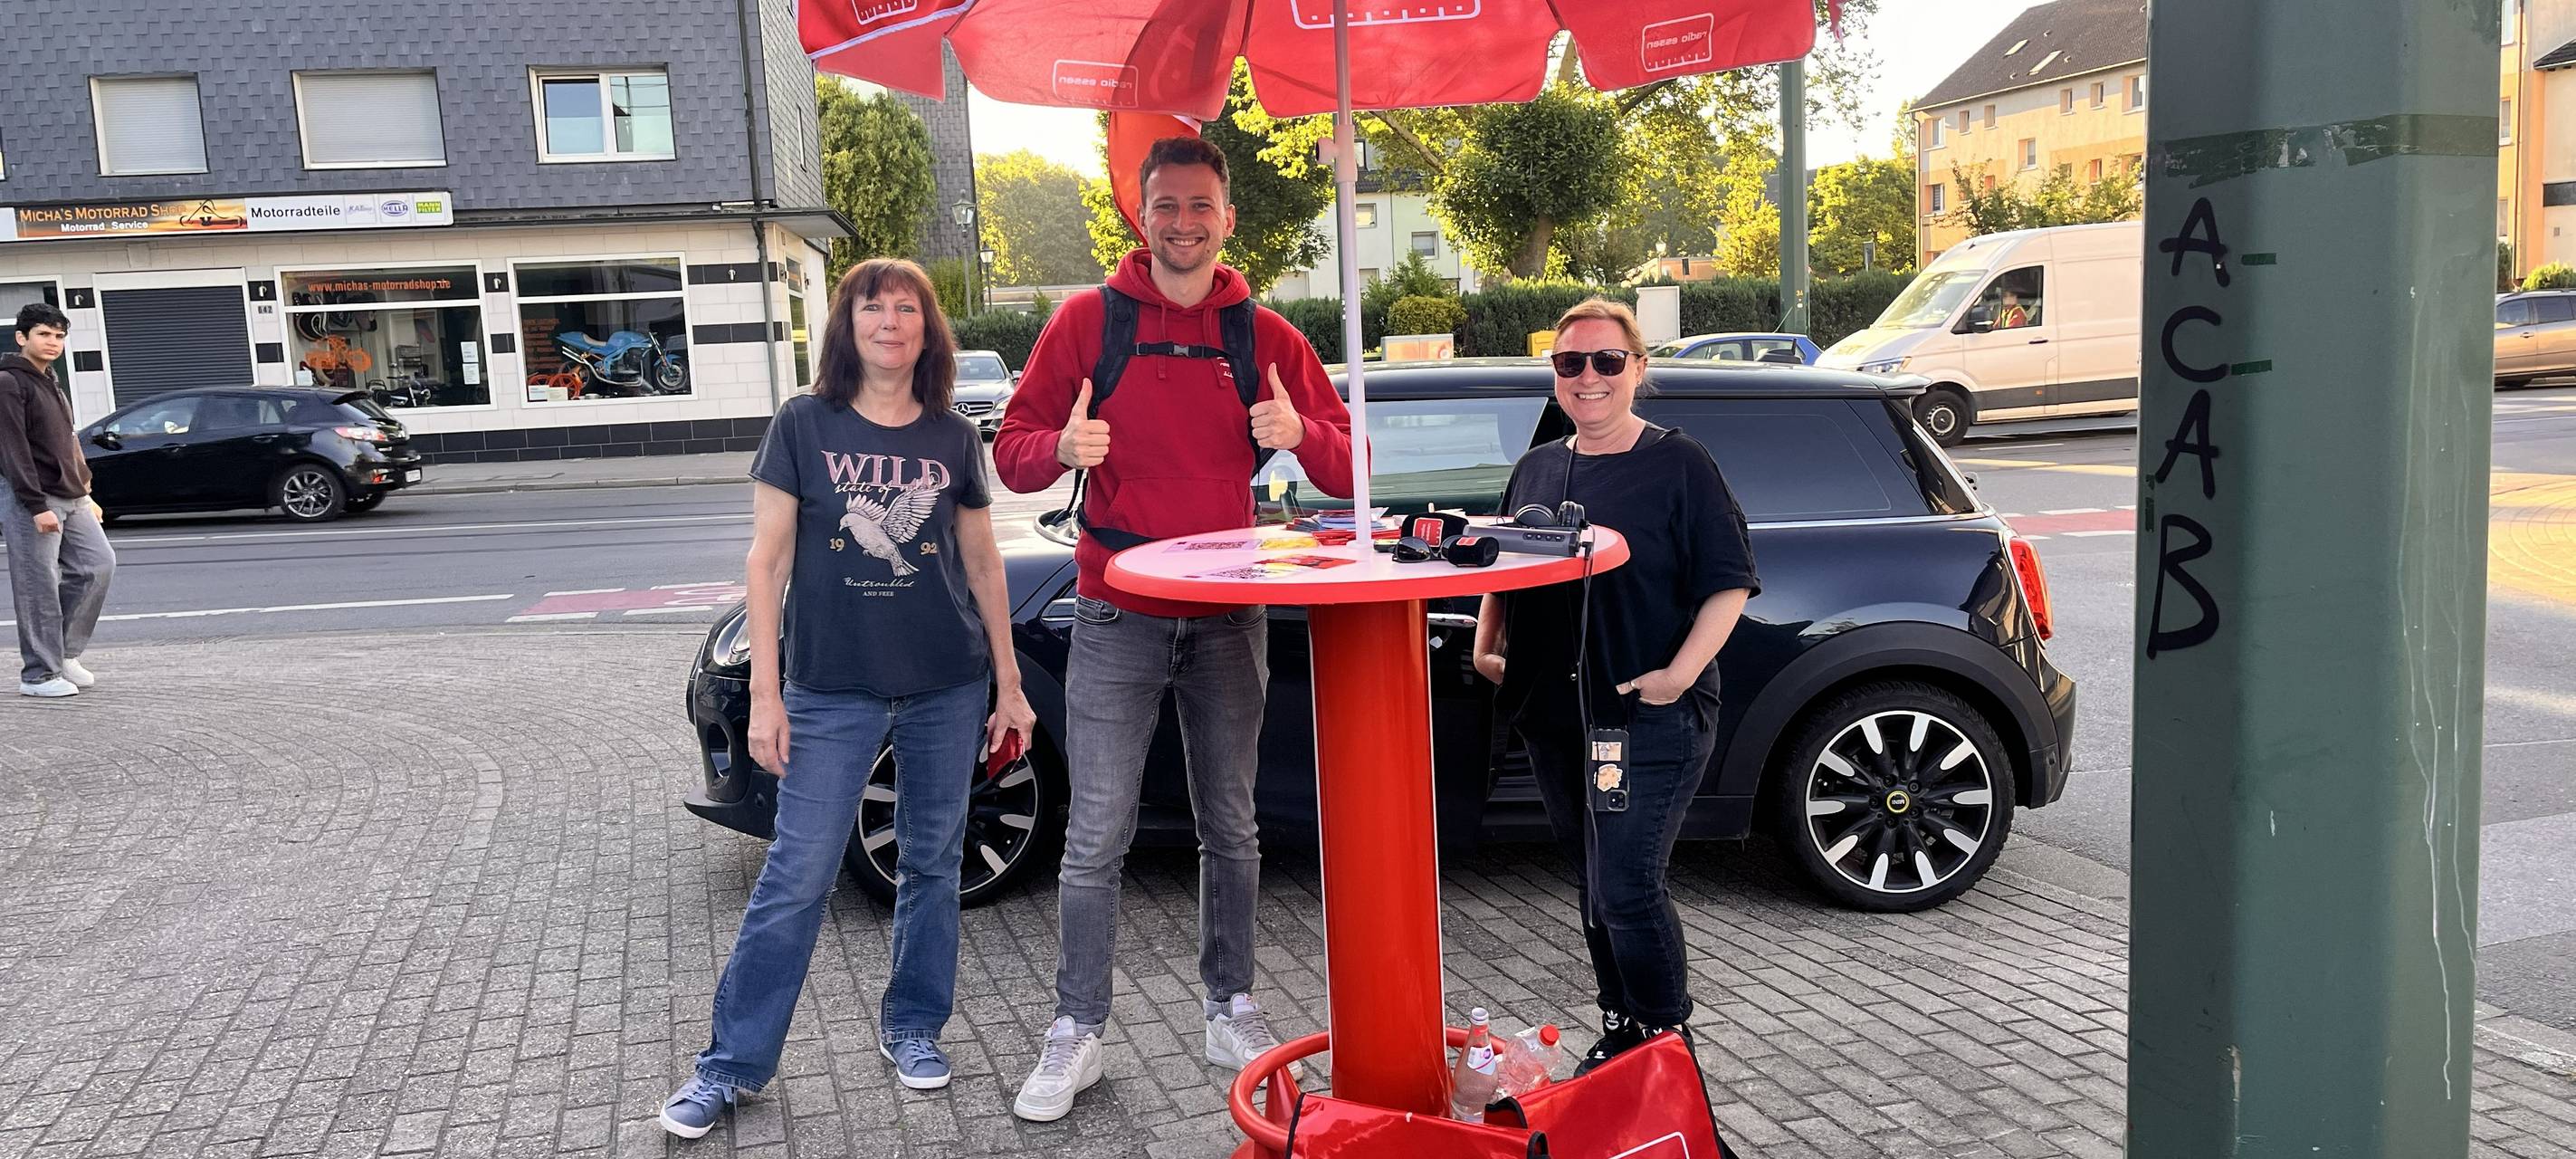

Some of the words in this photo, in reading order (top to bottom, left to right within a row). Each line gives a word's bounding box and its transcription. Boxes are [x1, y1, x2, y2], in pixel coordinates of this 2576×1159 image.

[75, 206, 148, 220] MOTORRAD
[251, 204, 340, 218] Motorradteile
[61, 221, 105, 233] Motorrad
[111, 220, 148, 231] Service
[308, 280, 451, 292] www.michas-motorradshop.de
[821, 450, 950, 490] WILD
[829, 538, 845, 551] 19
[920, 542, 938, 555] 92
